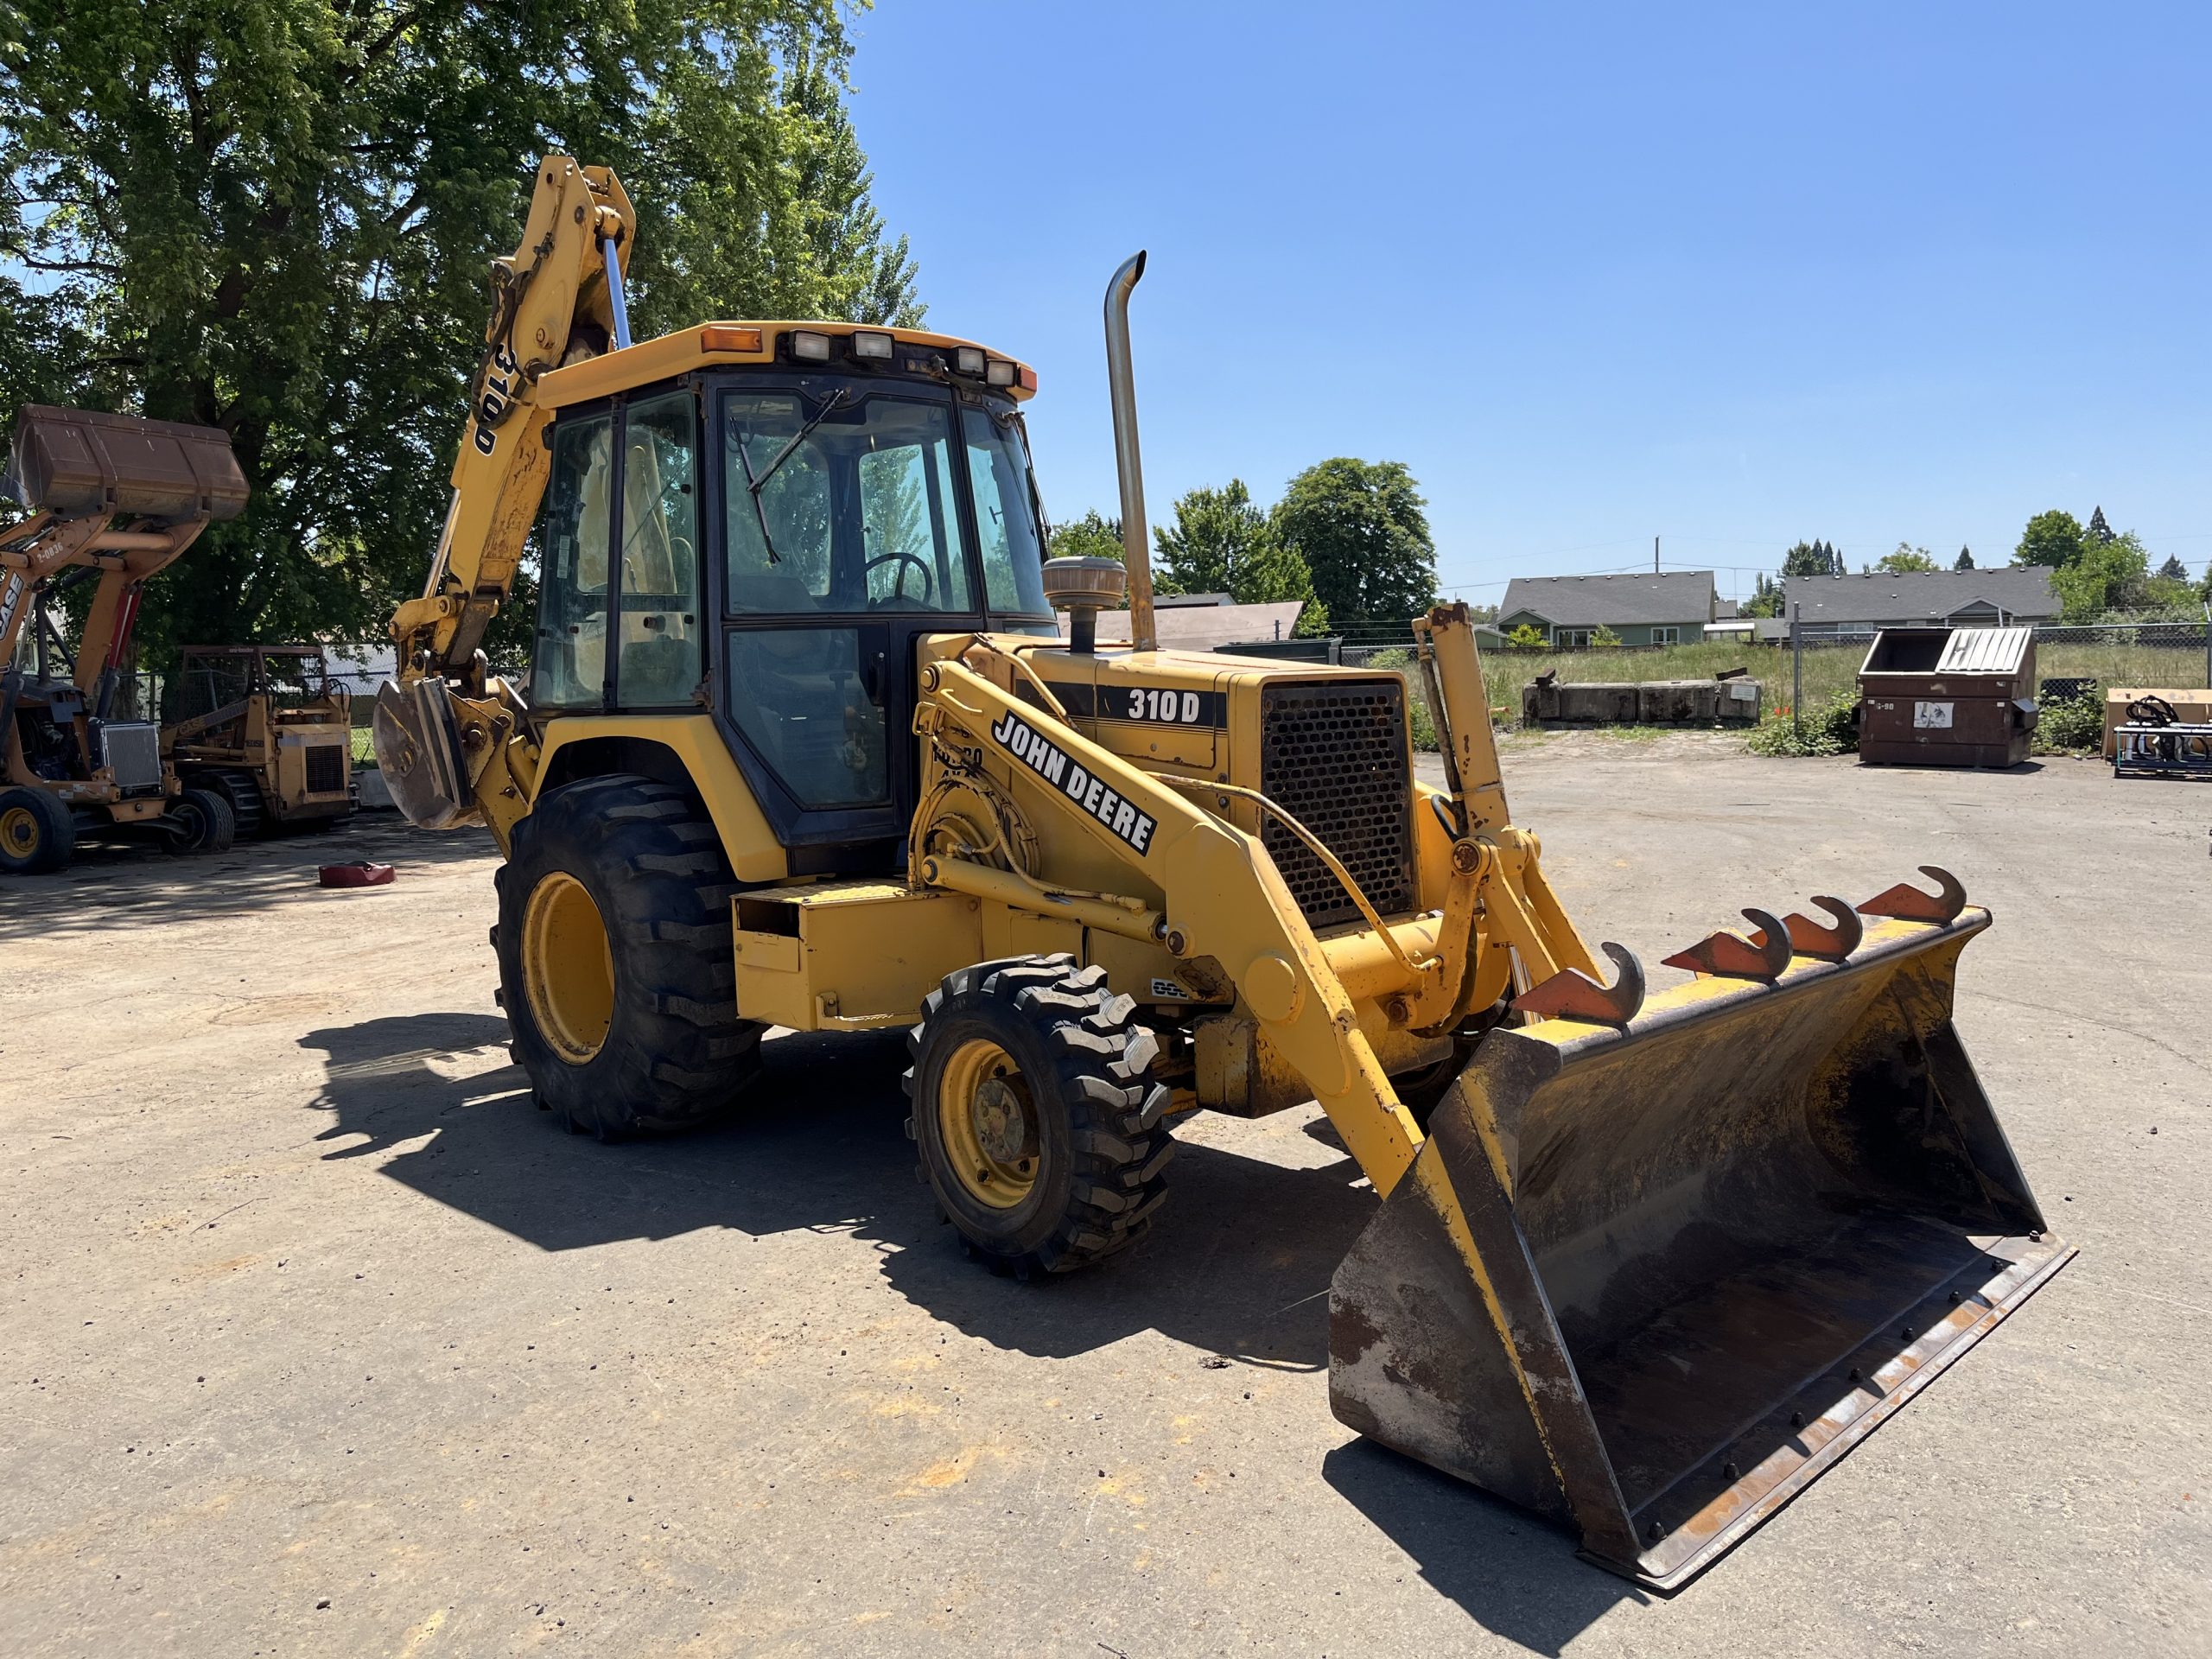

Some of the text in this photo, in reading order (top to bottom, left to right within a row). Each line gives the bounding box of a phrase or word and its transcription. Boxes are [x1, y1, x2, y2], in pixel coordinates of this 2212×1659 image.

[474, 343, 518, 456] 310D
[1128, 689, 1200, 722] 310D
[995, 715, 1153, 850] JOHN DEERE
